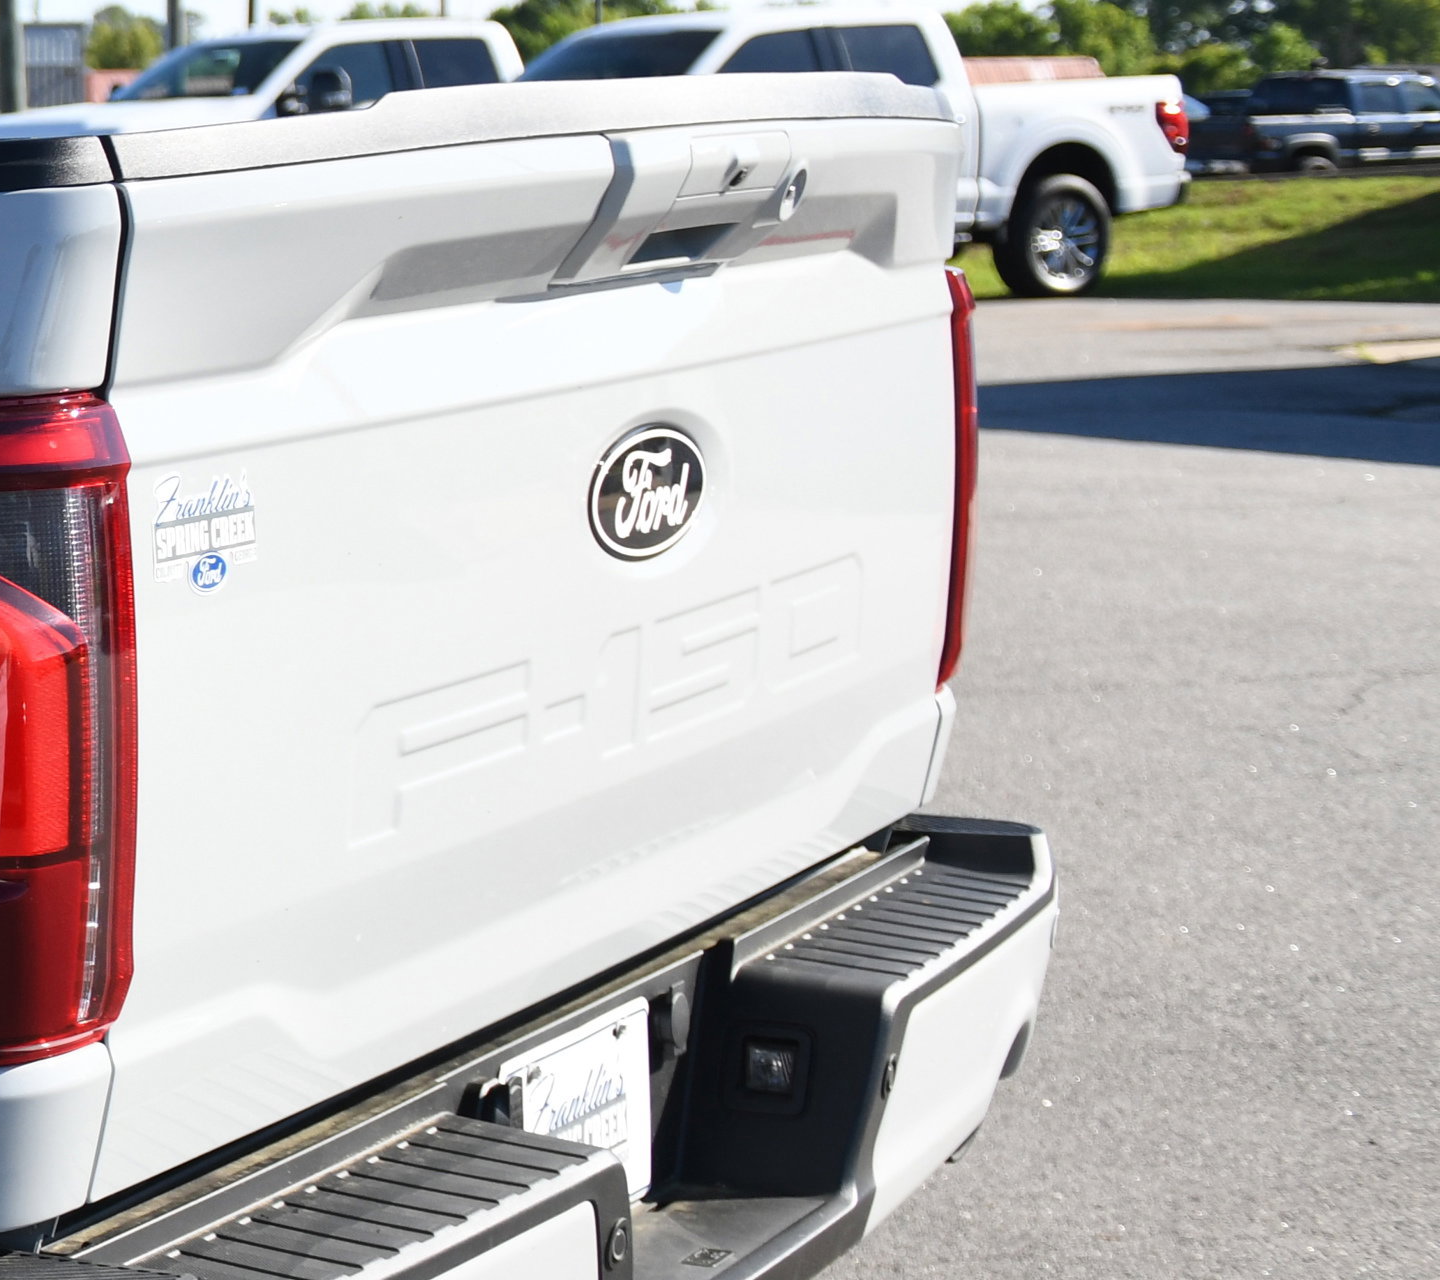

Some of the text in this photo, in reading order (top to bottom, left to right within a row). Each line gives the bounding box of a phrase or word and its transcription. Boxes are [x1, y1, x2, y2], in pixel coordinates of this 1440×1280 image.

[154, 474, 251, 527] Franklin's
[614, 447, 690, 539] Ford
[155, 510, 256, 560] SPRING CREEK
[197, 557, 223, 587] Ford
[347, 550, 864, 850] F-150
